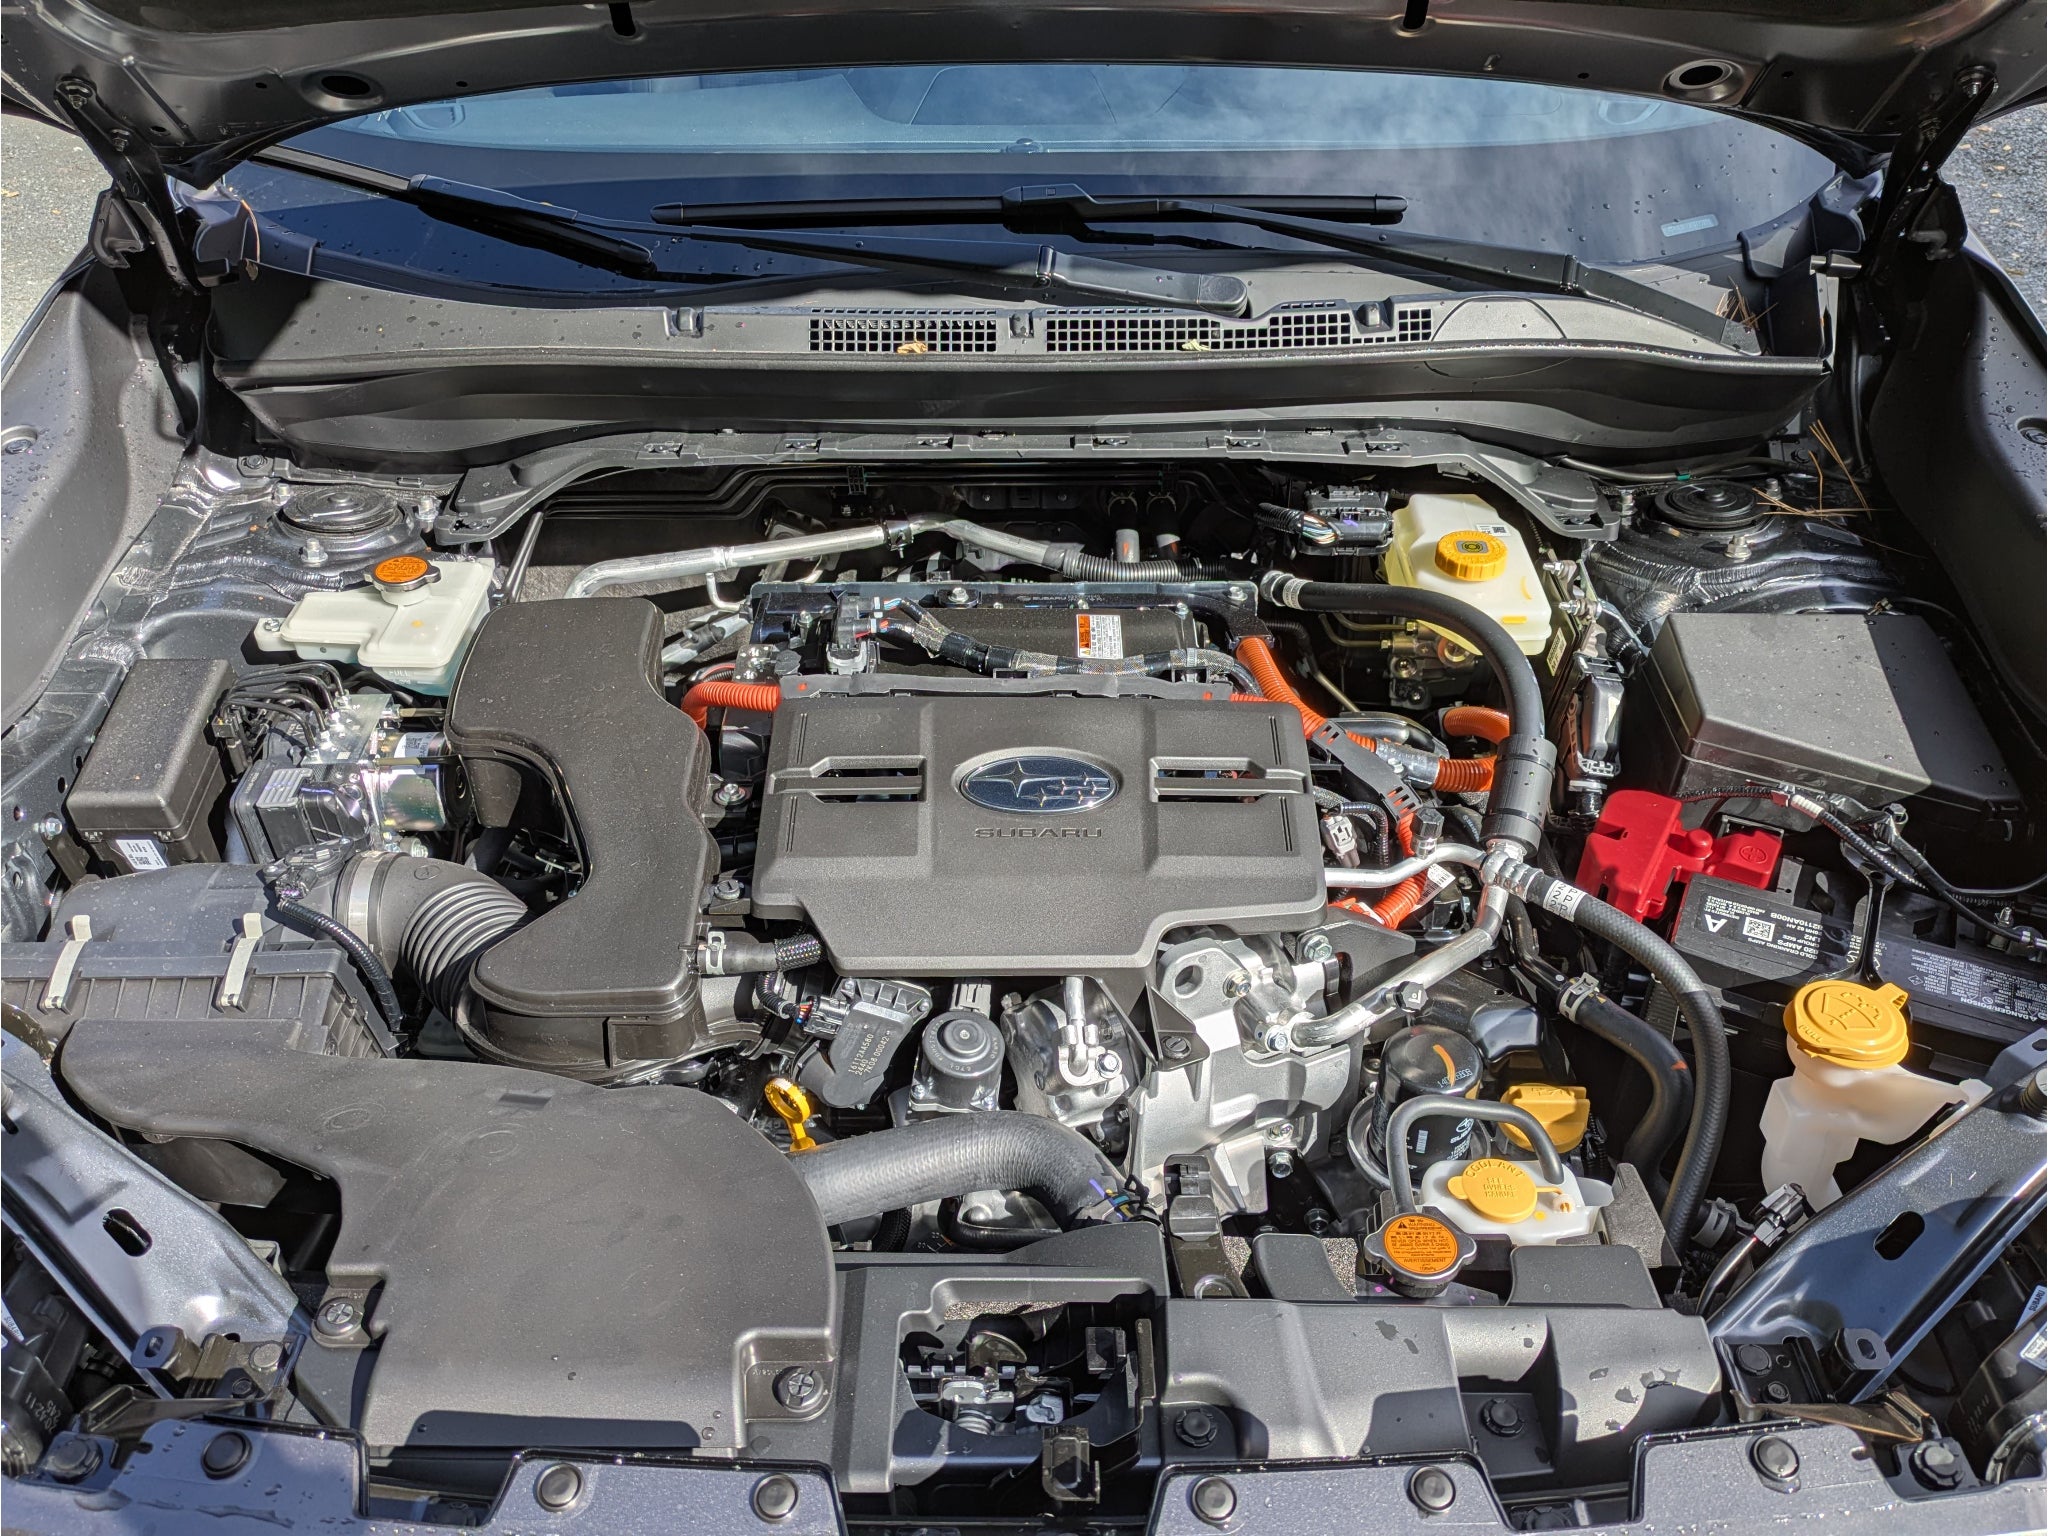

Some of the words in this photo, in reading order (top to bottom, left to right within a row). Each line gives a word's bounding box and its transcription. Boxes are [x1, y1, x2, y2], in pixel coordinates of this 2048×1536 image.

[974, 828, 1102, 838] SUBARU
[1704, 914, 1728, 933] A
[1747, 937, 1766, 946] AMPS
[1766, 943, 1799, 955] CRANKING
[1777, 939, 1802, 950] AMPS
[1797, 939, 1820, 948] GROUP
[1800, 951, 1818, 960] COLD
[1960, 997, 2029, 1020] DANGER/POISON
[847, 1033, 874, 1073] 16112AA580
[854, 1059, 869, 1076] 2440
[1465, 1160, 1526, 1178] COOLANT
[2029, 1289, 2046, 1312] SUBARU
[4, 1315, 21, 1338] SUBARU
